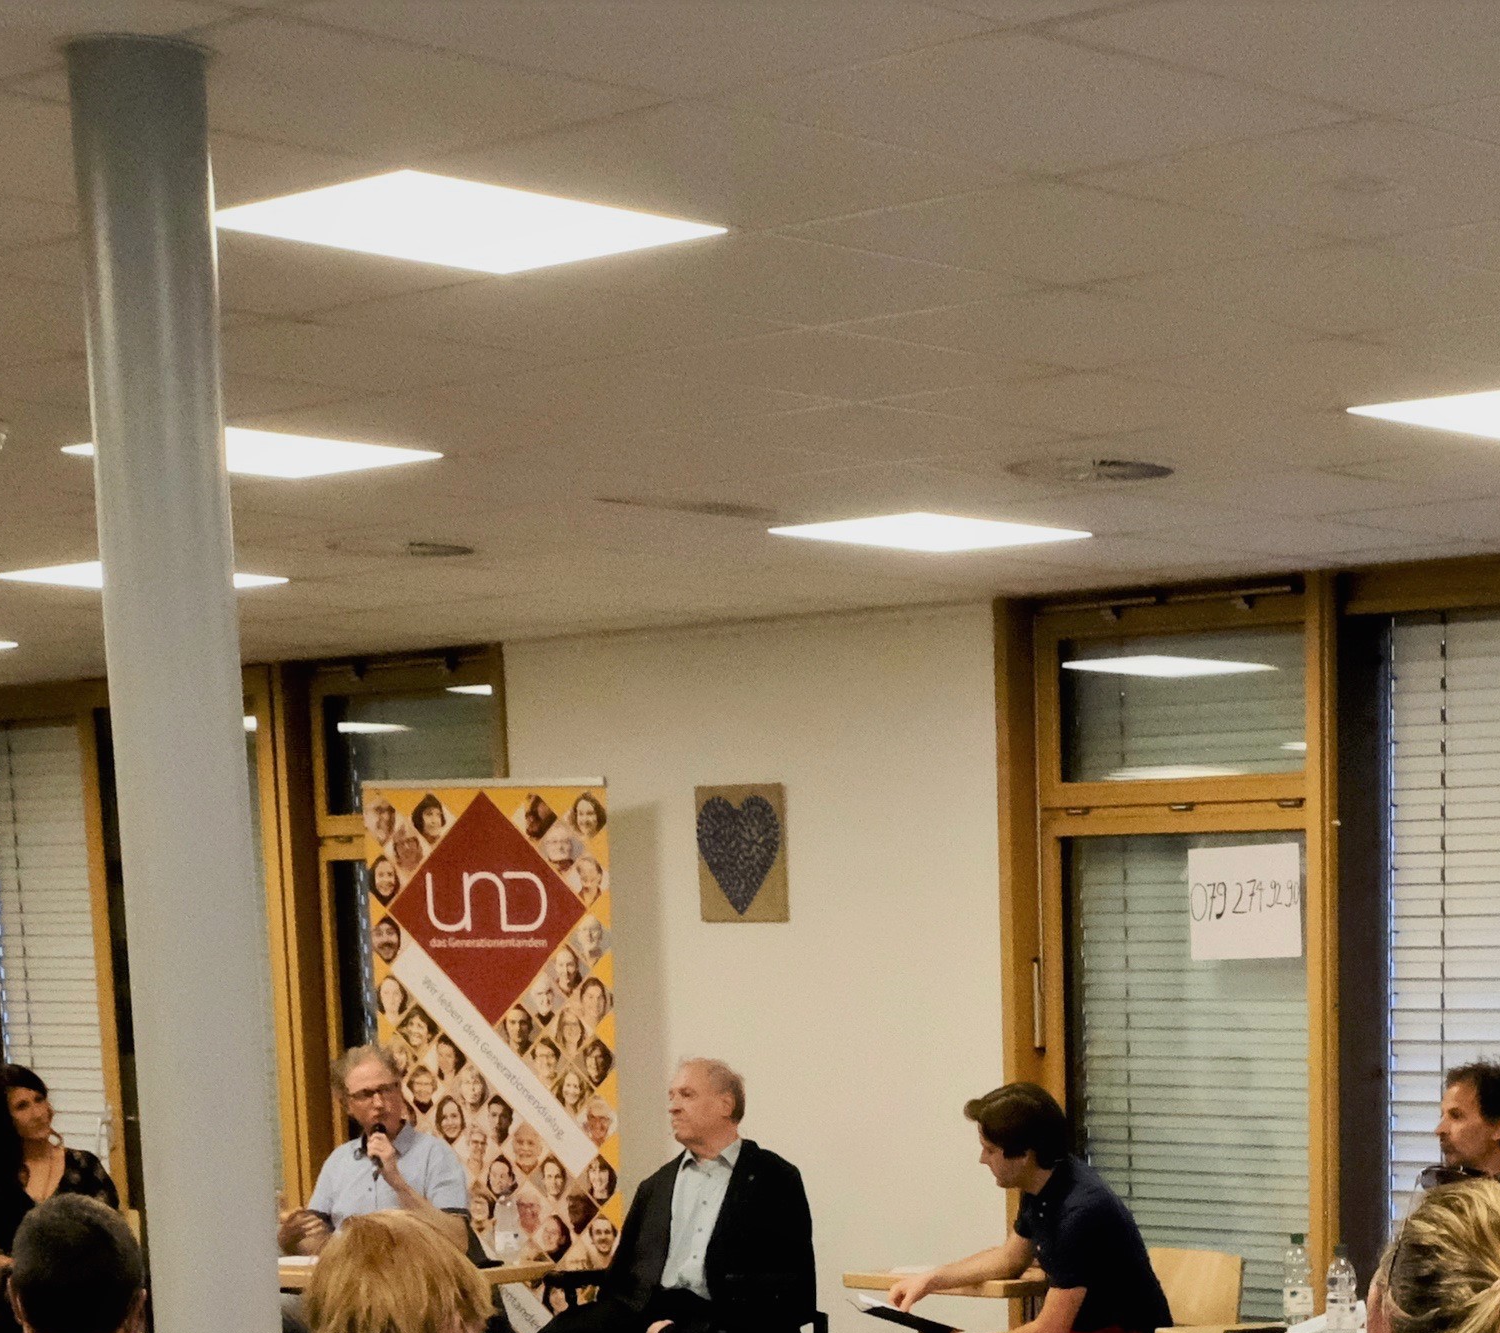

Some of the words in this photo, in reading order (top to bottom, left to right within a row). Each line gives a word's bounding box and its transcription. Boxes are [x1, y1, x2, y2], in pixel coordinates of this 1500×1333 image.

[1191, 881, 1227, 921] 079
[1266, 880, 1282, 908] 92
[422, 975, 438, 995] Wir
[438, 993, 464, 1025] leben
[463, 1023, 481, 1046] den
